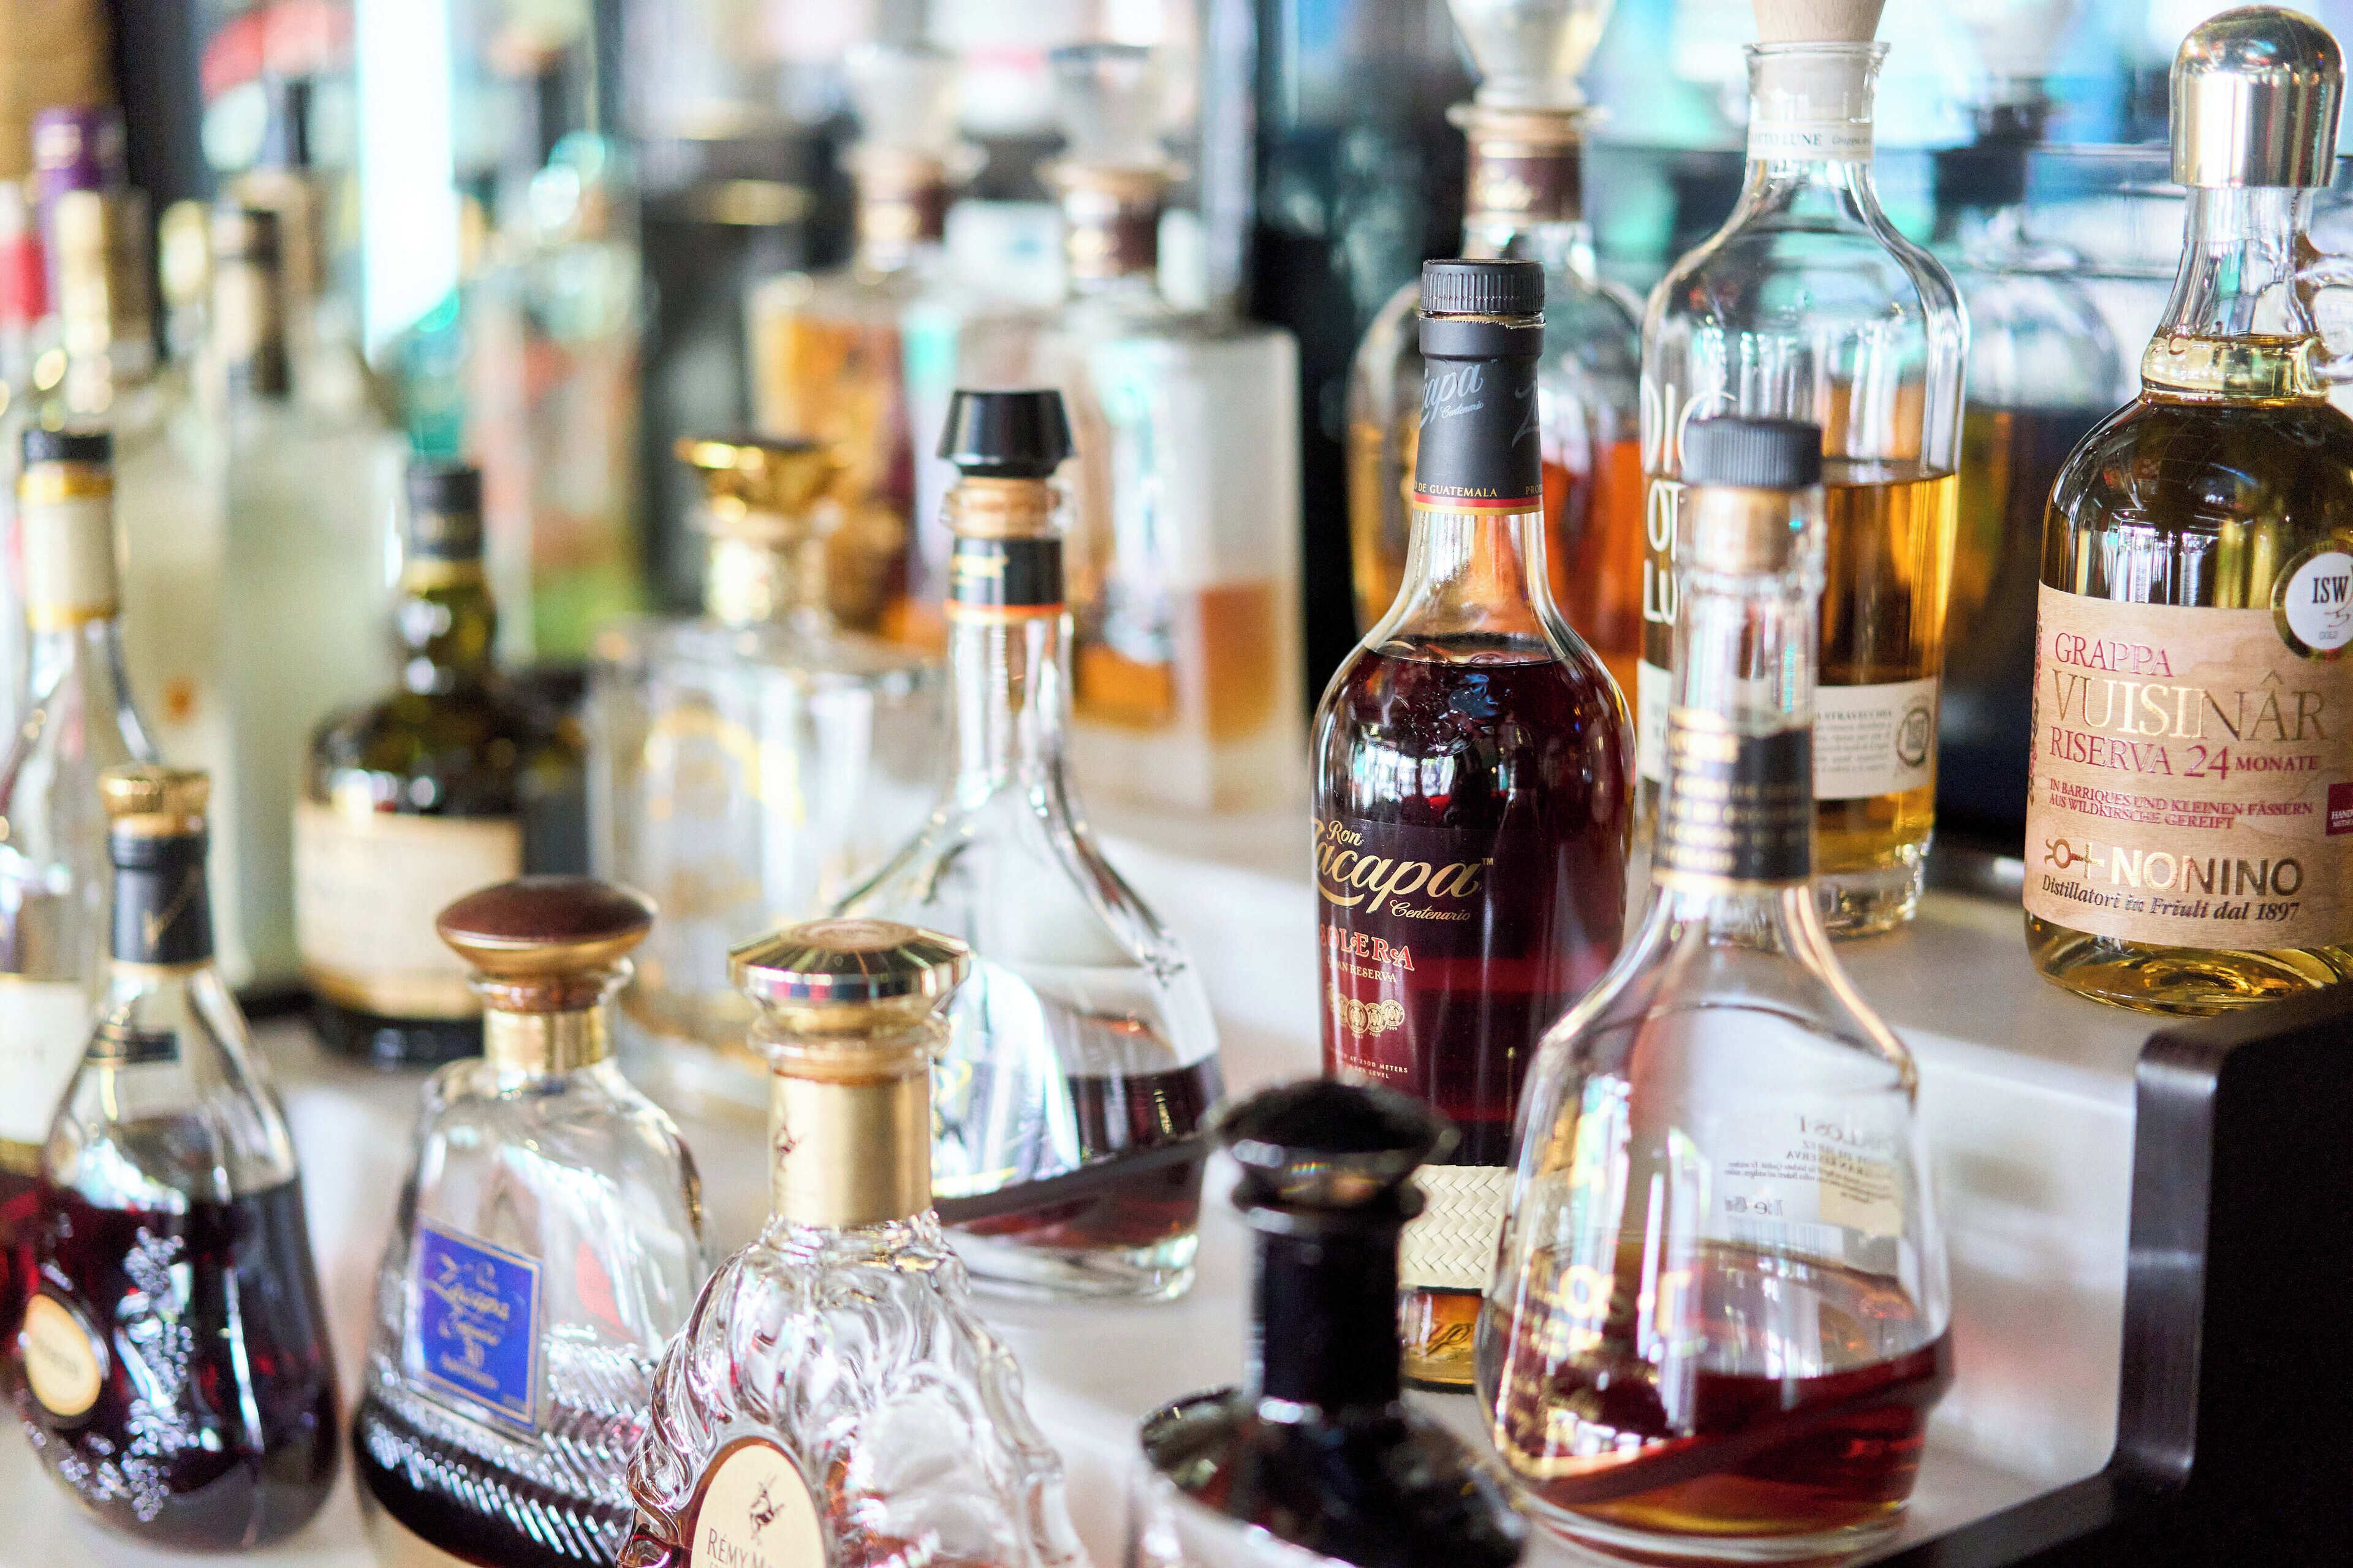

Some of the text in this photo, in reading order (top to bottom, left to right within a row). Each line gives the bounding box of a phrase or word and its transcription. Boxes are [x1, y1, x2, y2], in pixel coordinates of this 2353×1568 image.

[1418, 483, 1427, 493] DE
[1430, 485, 1498, 497] GUATEMALA
[2311, 576, 2349, 604] ISW
[2055, 632, 2174, 677] GRAPPA
[2053, 668, 2328, 741] VUISINÂR
[2049, 726, 2319, 780] RISERVA 24 MONATE
[2049, 793, 2234, 829] AUS WILDKIRSCHE GEREIFT
[2050, 778, 2314, 816] IN BARRIQUES UND KLEINEN FÄSSERN
[1326, 820, 1363, 847] Ron
[2111, 846, 2305, 896] NONINO
[1389, 899, 1471, 921] Centenario
[2042, 874, 2300, 922] Distillatori in Friuli dal 1897
[1320, 923, 1415, 971] SOLERA
[1349, 964, 1398, 983] RESERVA
[1369, 1070, 1389, 1079] LEVEL
[1379, 1063, 1408, 1073] METERS
[707, 1528, 748, 1568] RÉMY
